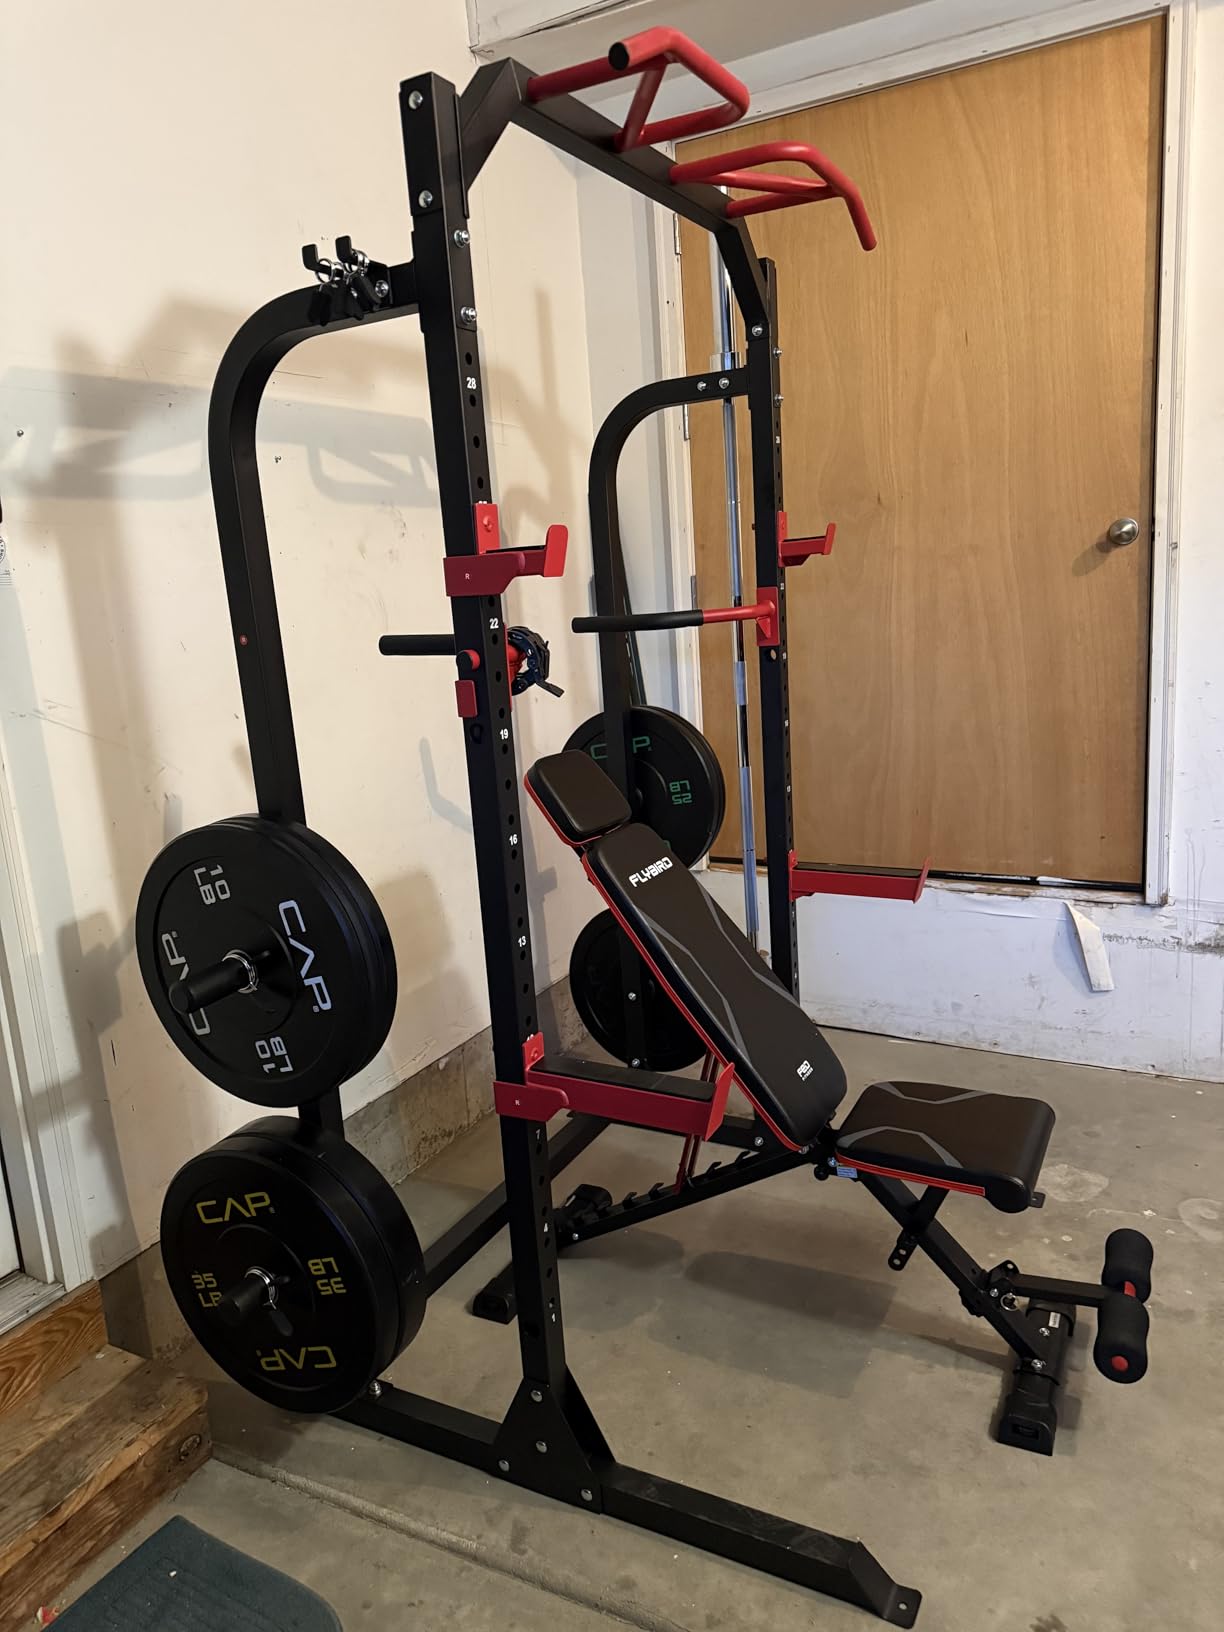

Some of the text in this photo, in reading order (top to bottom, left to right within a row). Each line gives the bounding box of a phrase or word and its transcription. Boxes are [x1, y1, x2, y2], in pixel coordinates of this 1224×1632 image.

[466, 376, 477, 390] 28
[489, 617, 499, 630] 22
[499, 728, 509, 740] 19
[590, 735, 652, 760] CP
[669, 780, 691, 793] LB
[671, 792, 693, 805] 25
[508, 833, 518, 846] 16
[628, 856, 673, 888] FLYBIRD
[193, 866, 217, 906] LB
[209, 863, 232, 901] 10
[517, 935, 527, 948] 13
[278, 899, 334, 1013] CAP
[255, 1039, 276, 1074] 10
[270, 1036, 295, 1073] LB
[196, 1191, 271, 1225] CAP
[307, 1257, 339, 1275] LB
[191, 1271, 217, 1289] 35
[316, 1278, 347, 1296] 35
[260, 1345, 337, 1371] CAP
